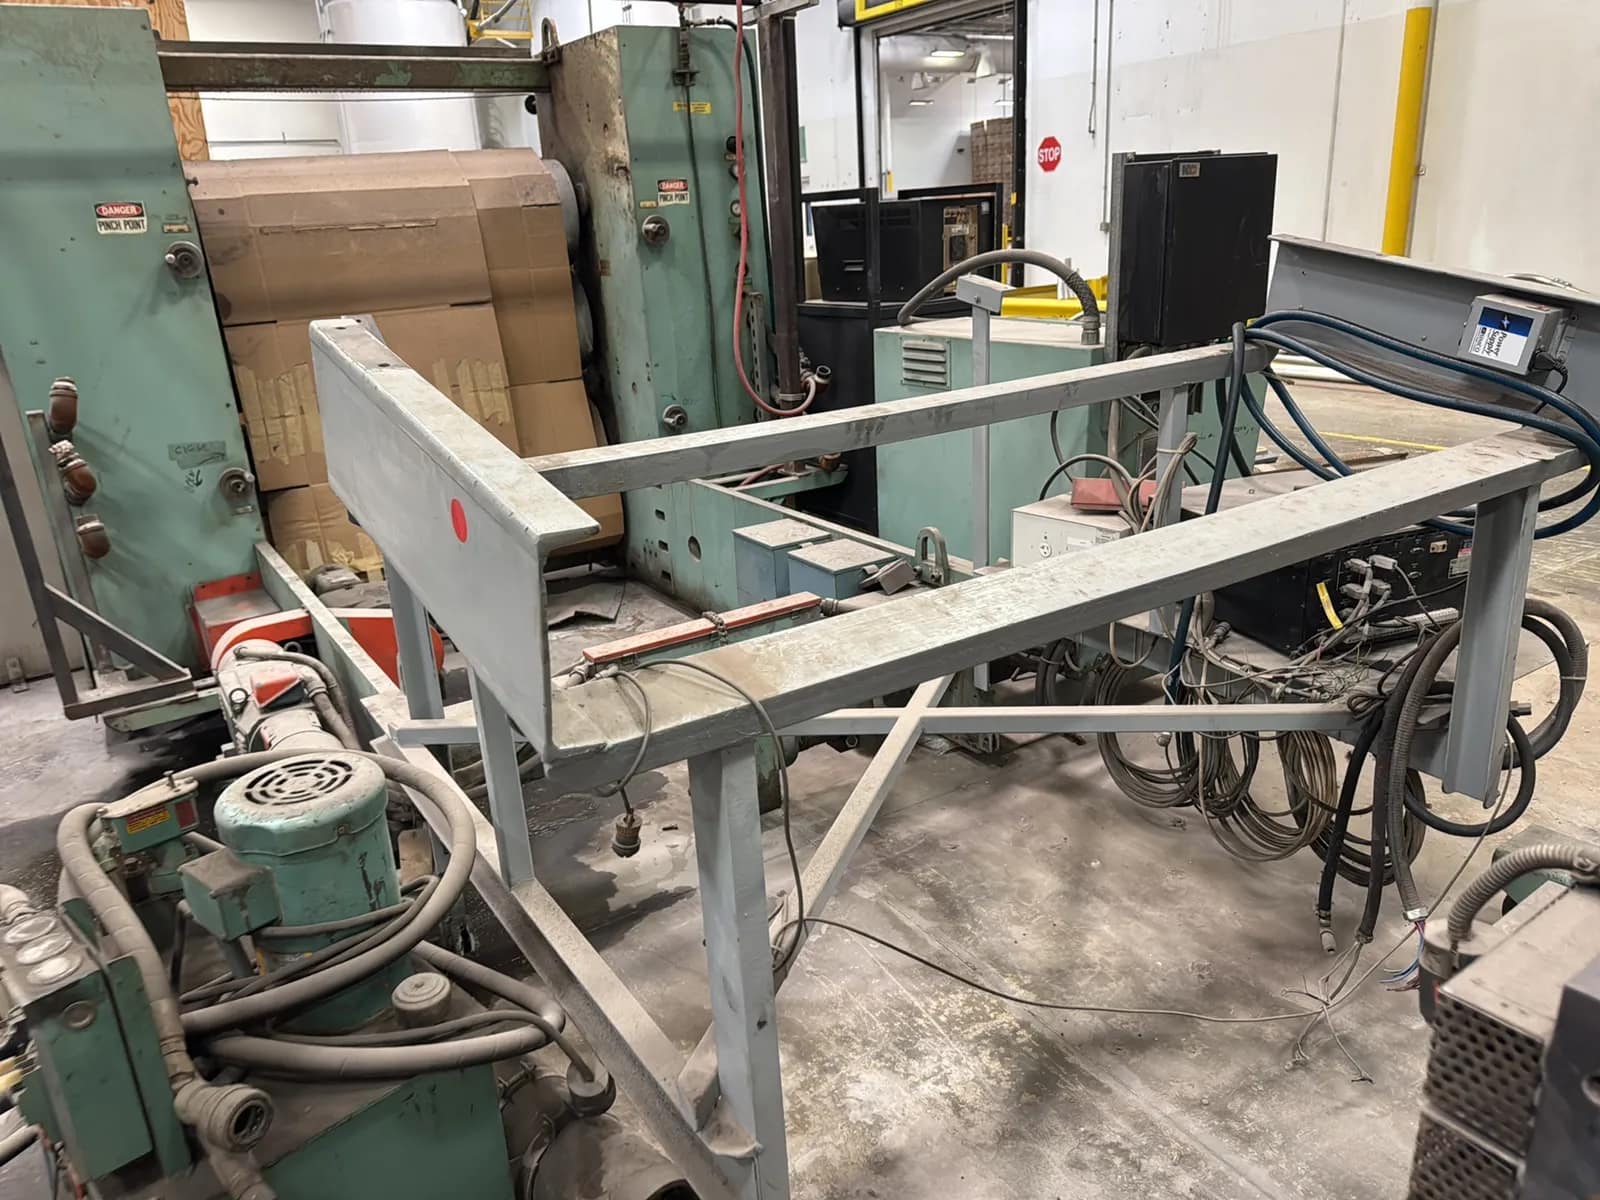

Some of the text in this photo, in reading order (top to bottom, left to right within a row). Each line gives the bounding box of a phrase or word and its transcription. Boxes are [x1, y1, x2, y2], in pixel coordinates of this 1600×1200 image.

[1039, 146, 1060, 163] STOP
[101, 205, 137, 215] DANGER
[98, 219, 145, 231] PINCH POINT
[1483, 329, 1499, 355] Supply
[1492, 331, 1507, 357] Power
